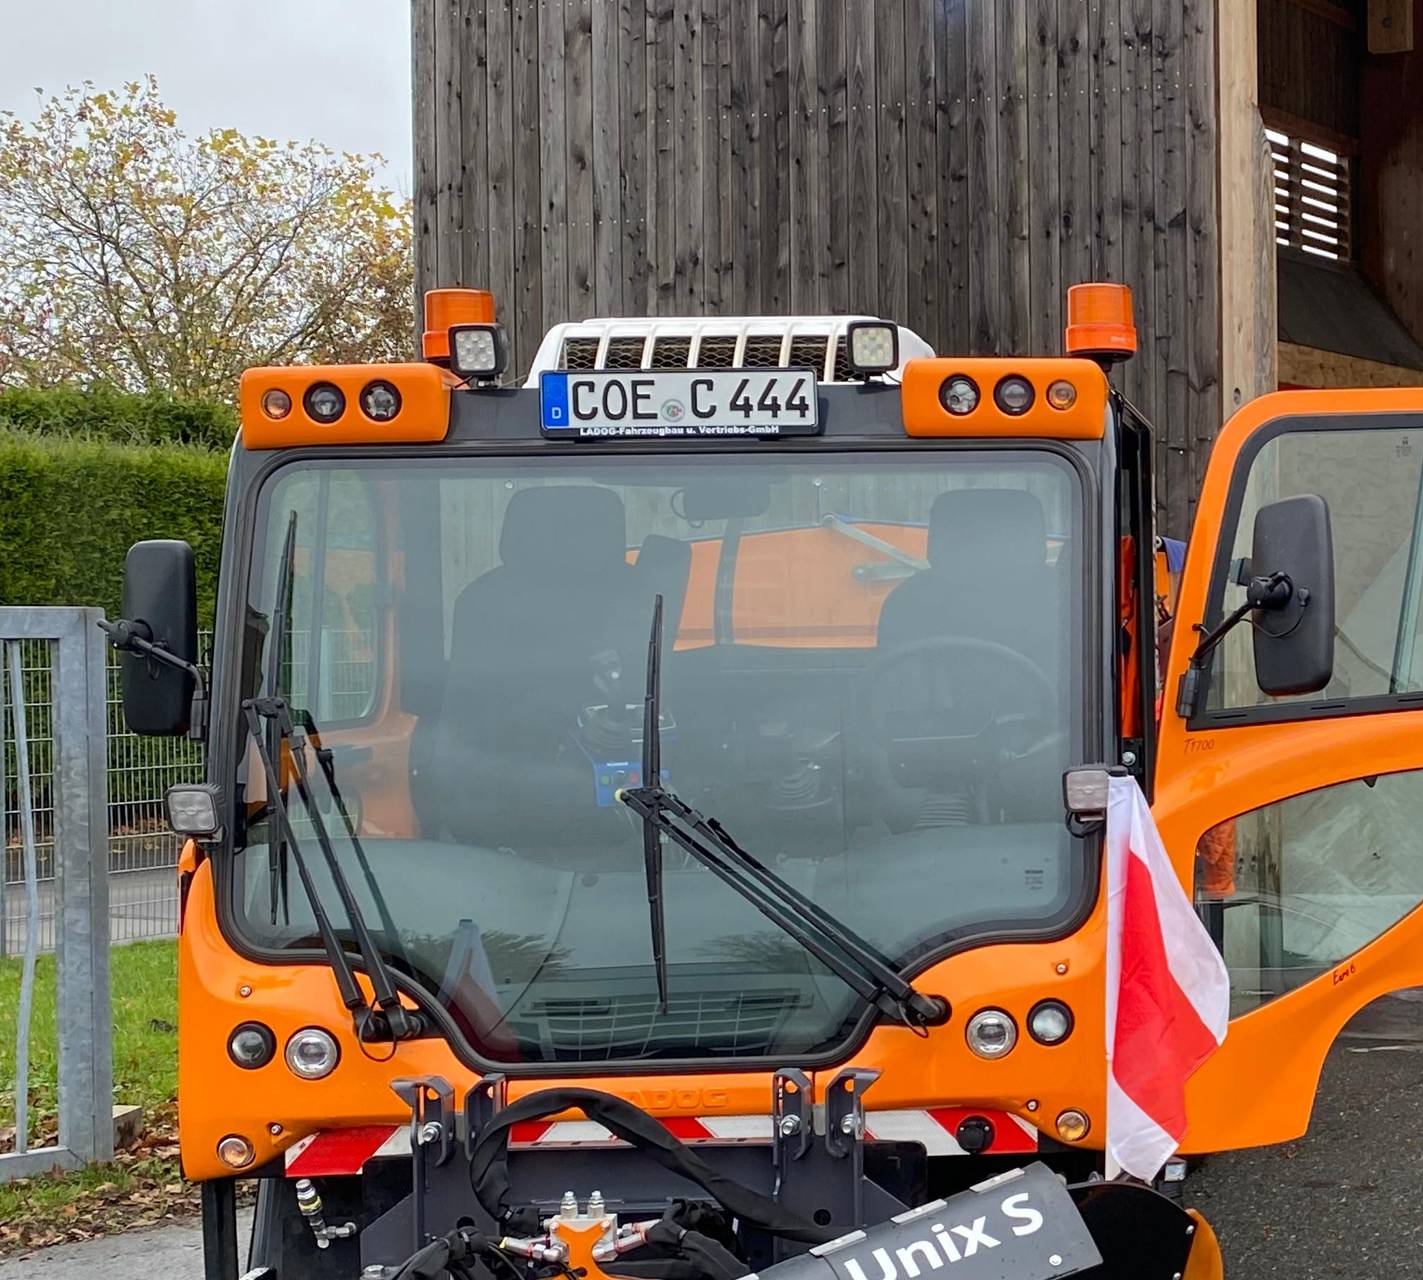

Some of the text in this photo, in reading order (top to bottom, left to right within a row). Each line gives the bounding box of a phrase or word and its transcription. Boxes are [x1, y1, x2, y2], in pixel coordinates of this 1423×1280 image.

[551, 378, 810, 421] D COE C 444
[580, 425, 780, 437] LADOG-Fahrzeugbau u. Vertriebs-GmbH
[621, 1088, 729, 1110] ADOG
[843, 1192, 1044, 1280] Unix S
